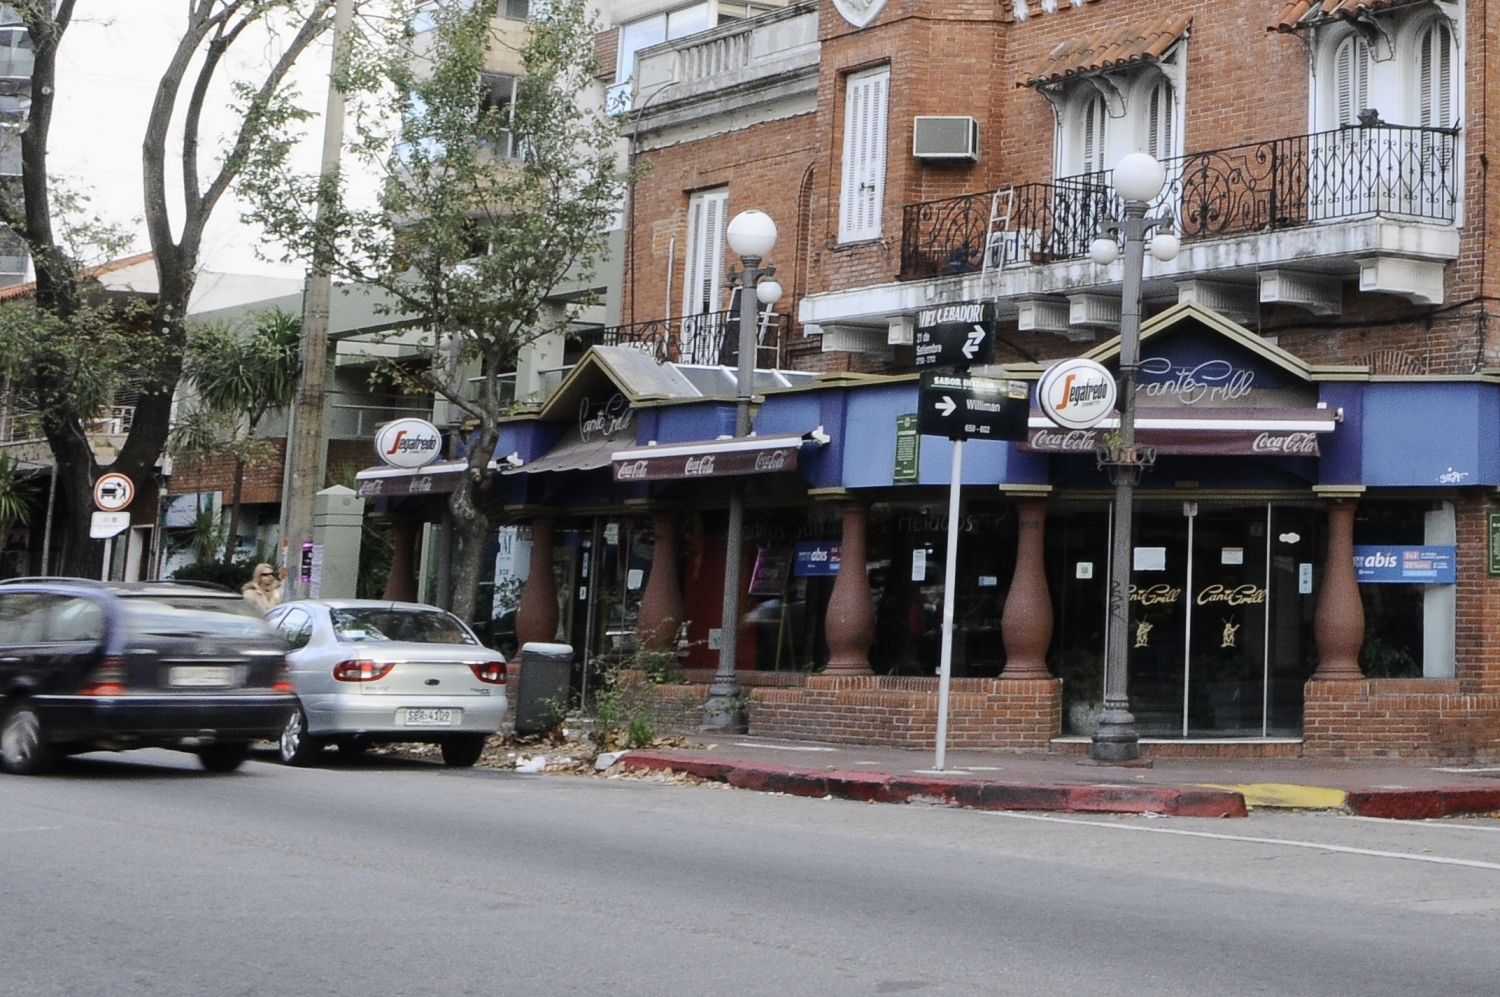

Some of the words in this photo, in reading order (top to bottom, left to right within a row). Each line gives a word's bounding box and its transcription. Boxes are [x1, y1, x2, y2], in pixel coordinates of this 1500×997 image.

[934, 376, 961, 386] SABOR
[1055, 374, 1107, 410] Segafredo
[966, 399, 1001, 412] Williman
[386, 430, 437, 454] Segafredo
[1031, 429, 1096, 450] Coca-Cola
[1253, 432, 1317, 453] Coca-Cola
[1364, 552, 1398, 568] abis
[1140, 584, 1181, 605] Grill
